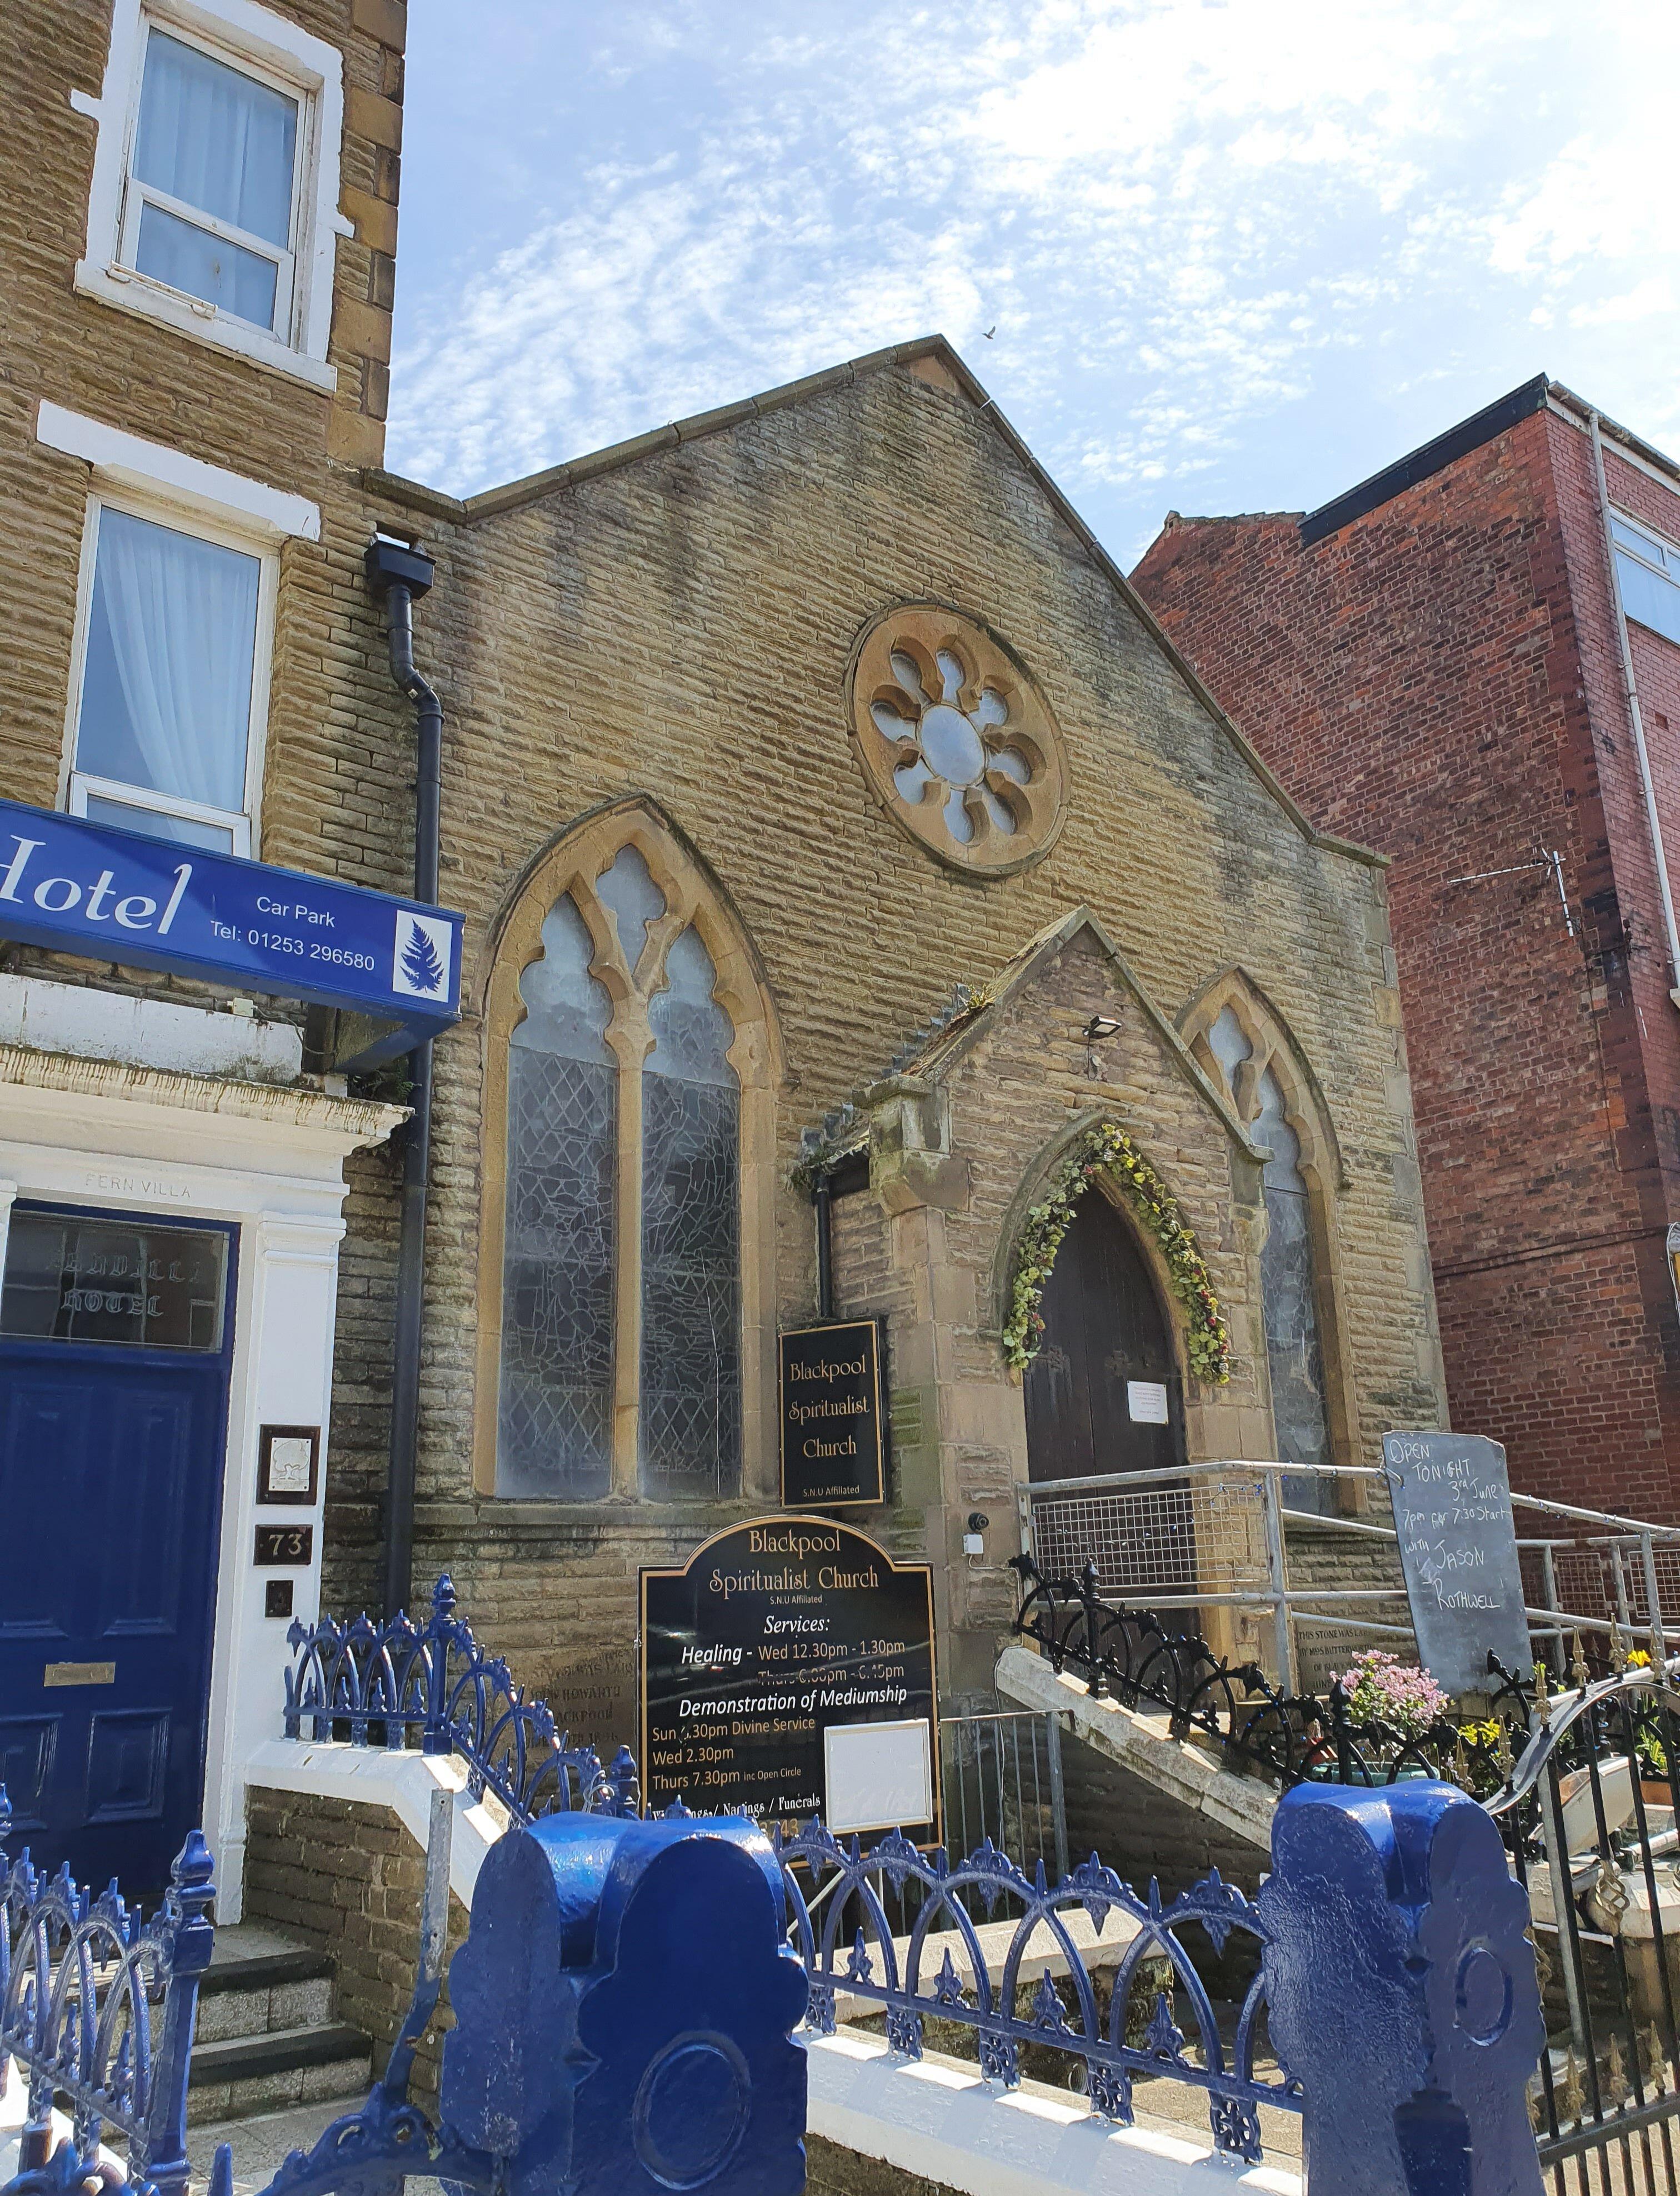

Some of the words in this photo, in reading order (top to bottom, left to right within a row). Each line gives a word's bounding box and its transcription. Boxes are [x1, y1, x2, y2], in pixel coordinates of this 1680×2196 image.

[256, 896, 290, 916] Car
[295, 904, 336, 928] Park
[210, 920, 242, 942] Tel:
[248, 929, 304, 956] 01253
[310, 943, 375, 971] 296580
[85, 1173, 134, 1191] FERN
[141, 1180, 191, 1198] VILLA
[789, 1353, 867, 1383] Blackpool
[789, 1394, 870, 1426] Spiritualist
[802, 1434, 858, 1458] Church
[1390, 1439, 1430, 1464] OPEN
[1412, 1458, 1471, 1483] TONIGHT
[826, 1484, 859, 1495] Affiliated
[1470, 1477, 1499, 1499] June
[1402, 1509, 1426, 1530] 7pm
[1476, 1505, 1511, 1521] Start
[268, 1533, 303, 1556] 73
[749, 1528, 841, 1560] Blackpool
[1404, 1538, 1429, 1554] WITH
[1434, 1539, 1484, 1571] JASON
[709, 1565, 811, 1600] Spiritualist
[818, 1564, 879, 1589] Church
[1432, 1578, 1500, 1610] ROTHWELL
[791, 1594, 822, 1604] Affiliated
[763, 1615, 831, 1634] Services:
[1299, 1630, 1314, 1639] THIS
[1315, 1629, 1338, 1639] STONE
[1338, 1628, 1353, 1637] WAS
[681, 1643, 742, 1665] Healing
[758, 1643, 788, 1661] Wed
[792, 1642, 848, 1660] 12.30pm
[860, 1639, 906, 1655] 1.30pm
[679, 1692, 796, 1717] Demonstration
[801, 1689, 817, 1713] of
[819, 1684, 907, 1707] Mediumship
[652, 1727, 676, 1742] Sun
[732, 1719, 769, 1737] Divine
[773, 1716, 816, 1732] Service
[652, 1749, 682, 1765] Wed
[686, 1747, 734, 1764] 2.30pm
[652, 1774, 689, 1790] Thurs
[692, 1770, 740, 1787] 7.30pm
[743, 1771, 756, 1781] inc
[757, 1769, 778, 1781] Open
[780, 1767, 802, 1778] Circle
[778, 1792, 821, 1810] Funerals
